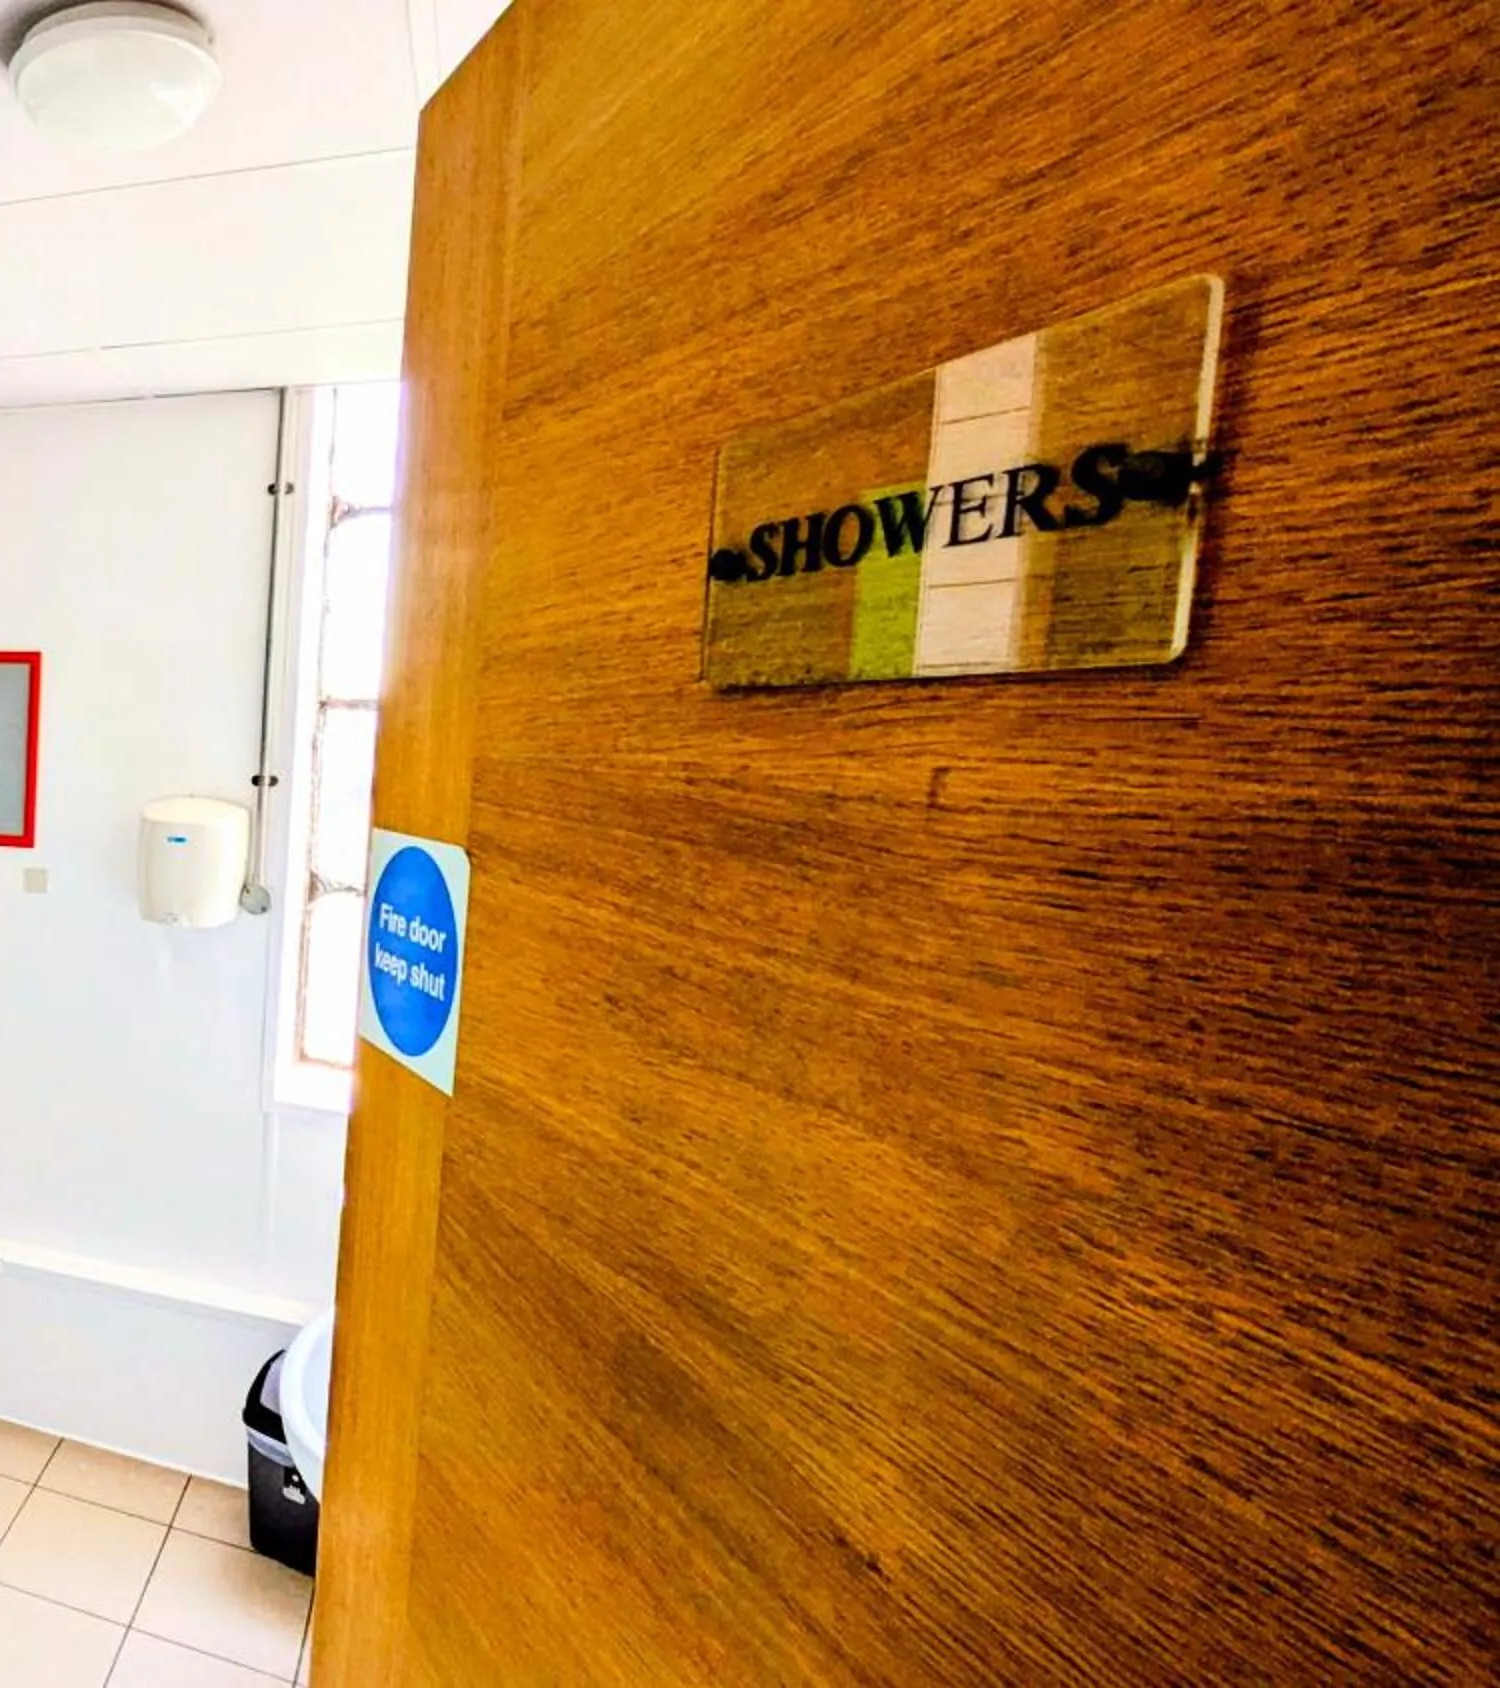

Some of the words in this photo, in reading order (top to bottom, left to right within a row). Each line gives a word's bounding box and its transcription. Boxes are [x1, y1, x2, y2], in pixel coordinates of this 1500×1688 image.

[746, 443, 1129, 582] SHOWERS
[379, 903, 406, 936] Fire
[409, 916, 448, 953] door
[375, 943, 407, 985] keep
[410, 962, 446, 1001] shut
